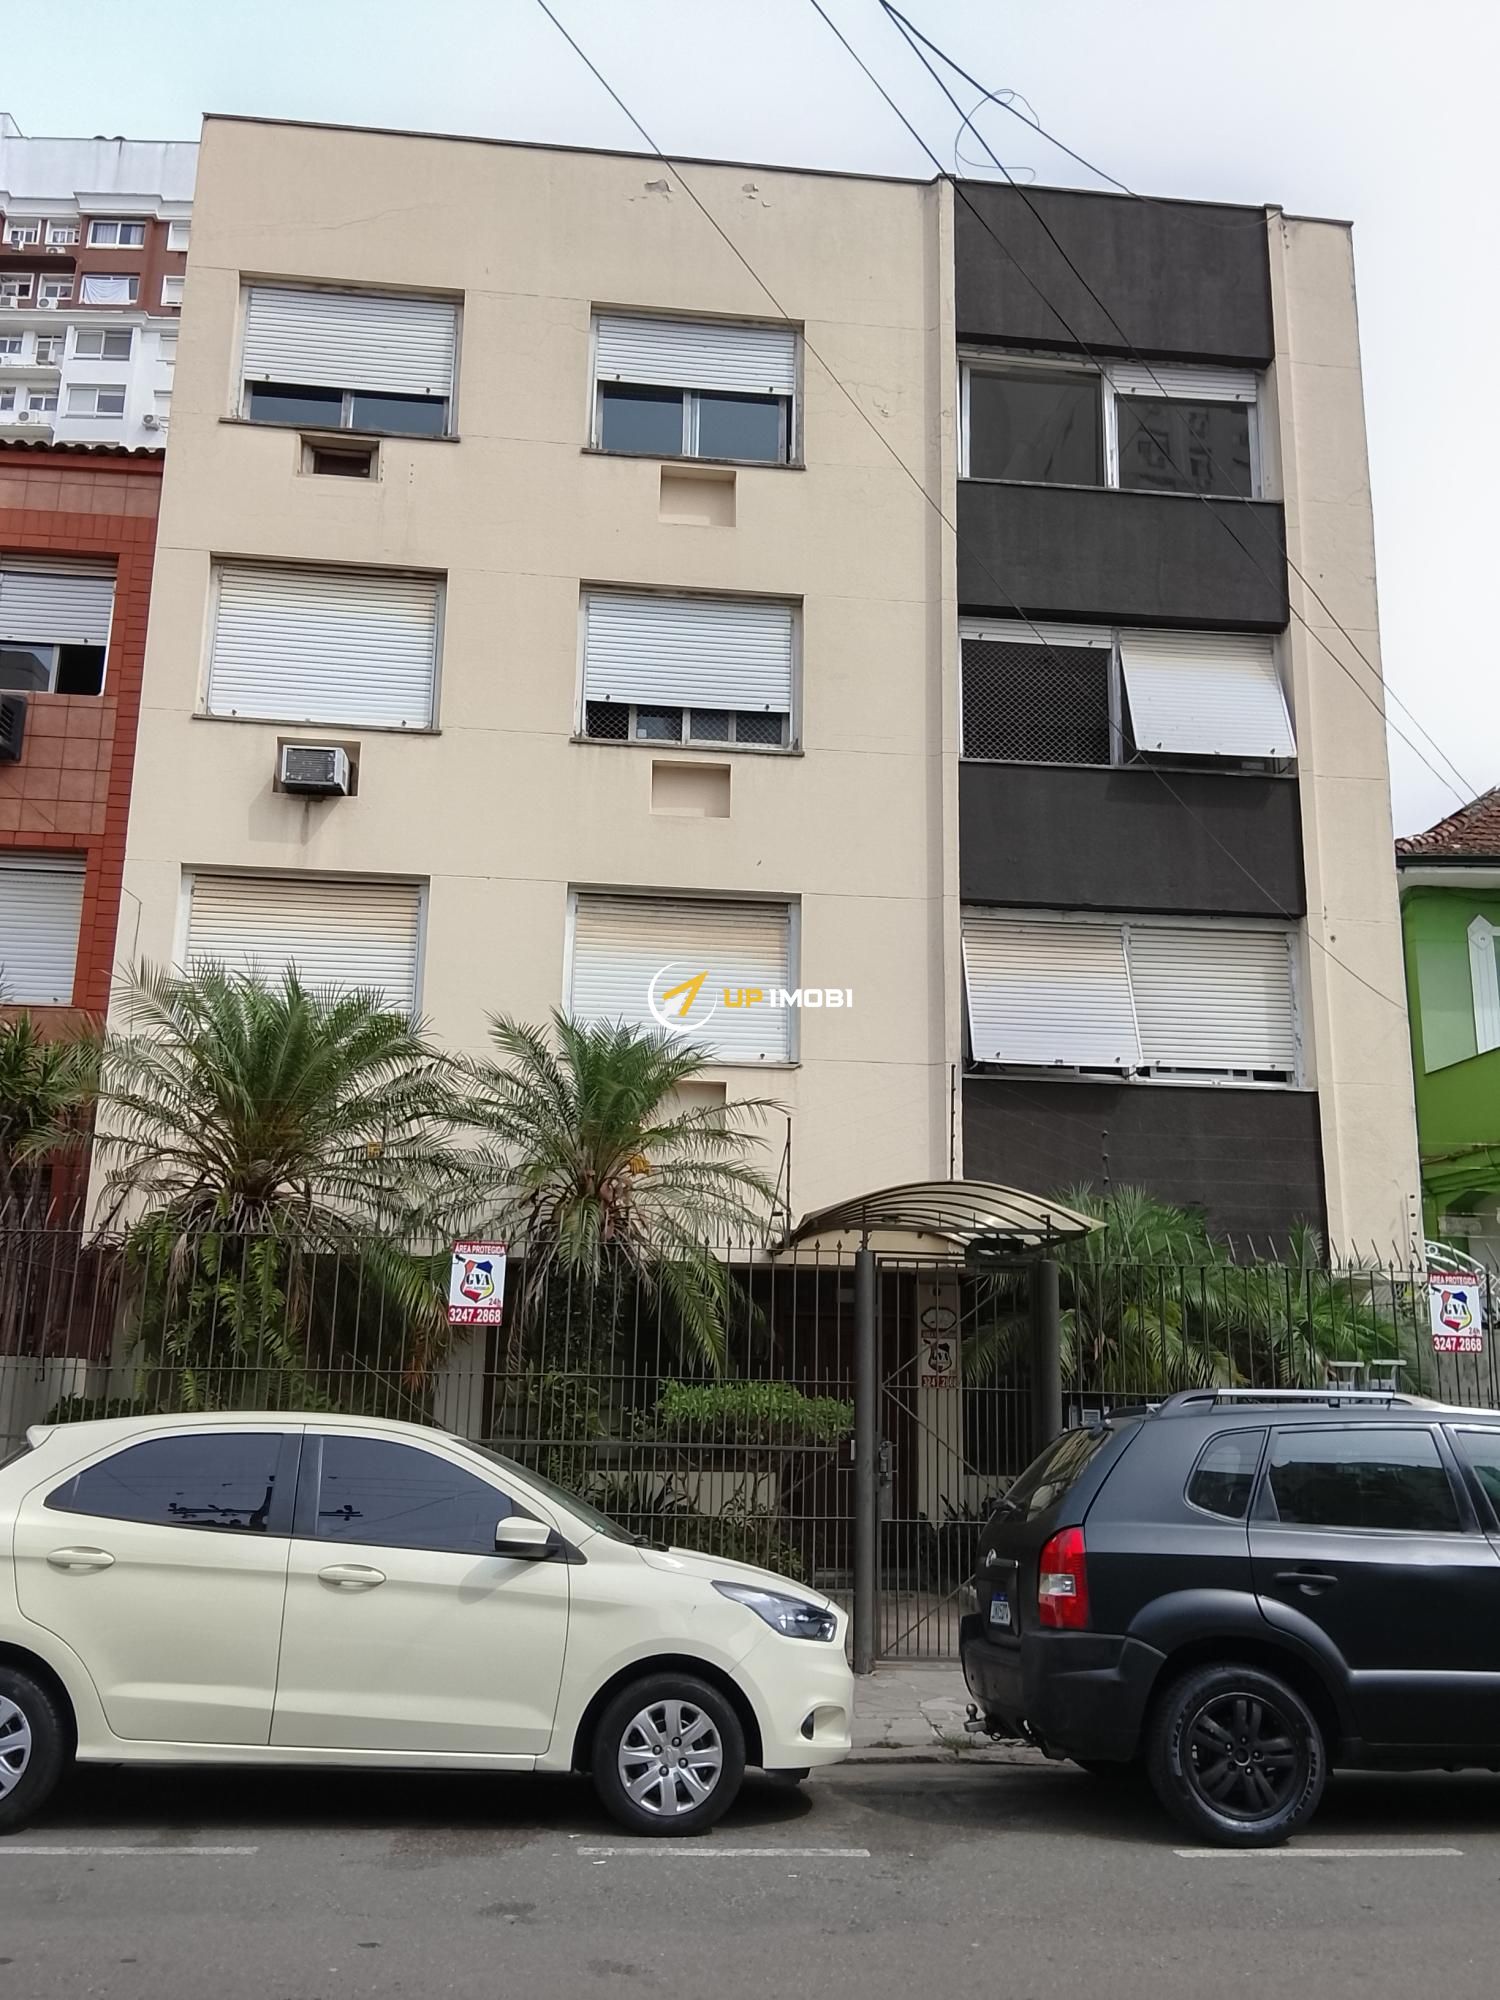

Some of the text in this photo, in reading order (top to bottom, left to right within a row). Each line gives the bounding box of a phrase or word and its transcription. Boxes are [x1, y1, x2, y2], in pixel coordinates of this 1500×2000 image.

[472, 1245, 506, 1255] PROTEGIDA
[466, 1273, 490, 1286] GVA
[1445, 1275, 1477, 1285] PROTEGIDA
[449, 1307, 501, 1323] 3247.2868
[1443, 1303, 1468, 1316] GVA
[1433, 1336, 1483, 1352] 3247.2868
